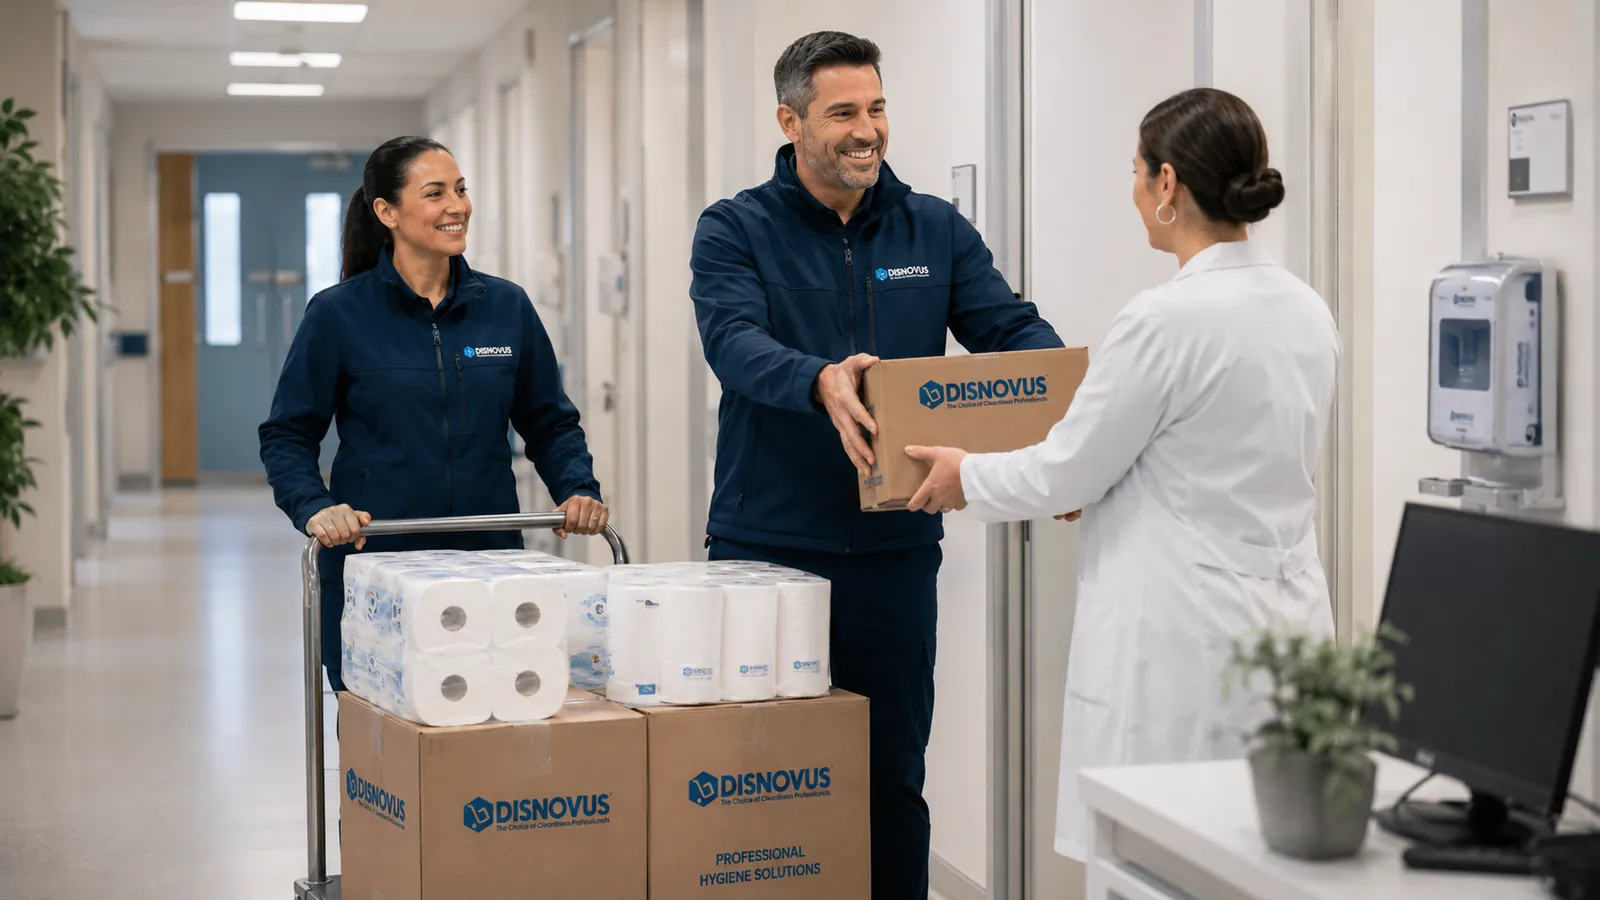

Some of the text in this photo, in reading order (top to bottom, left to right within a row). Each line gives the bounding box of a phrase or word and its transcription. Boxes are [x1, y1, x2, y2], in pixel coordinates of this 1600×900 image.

[888, 266, 929, 277] DISNOVUS
[475, 346, 512, 355] DISNOVUS
[945, 376, 1047, 402] DISNOVUS
[720, 766, 831, 798] DISNOVUS
[358, 776, 405, 822] DISNOVUS
[496, 793, 610, 823] DISNOVUS
[716, 846, 806, 866] PROFESSIONAL
[700, 862, 821, 887] HYGIENE SOLUTIONS
